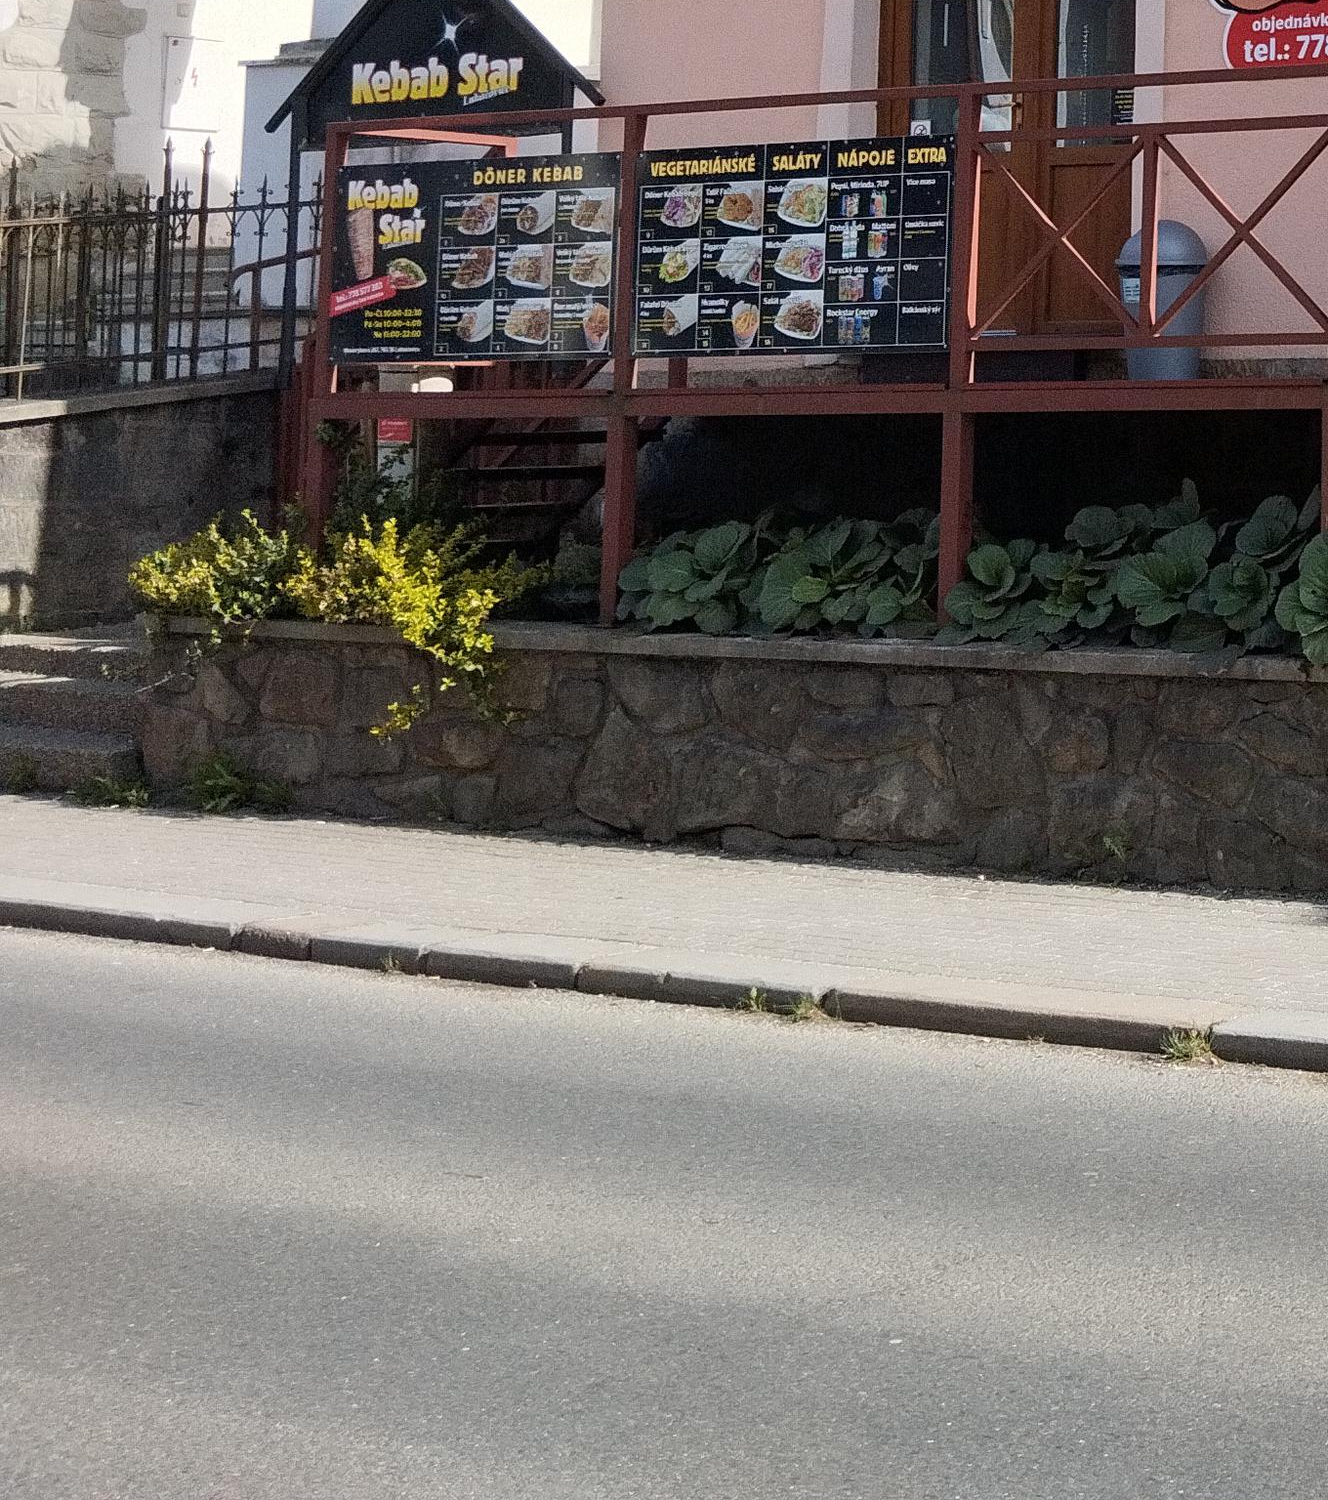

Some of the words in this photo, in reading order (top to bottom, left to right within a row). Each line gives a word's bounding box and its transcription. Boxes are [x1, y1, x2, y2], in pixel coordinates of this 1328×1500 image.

[1243, 39, 1291, 62] tel.:
[352, 56, 449, 105] Kebab
[457, 52, 523, 96] Star
[651, 153, 756, 177] VEGETARIÁNSKÉ
[772, 151, 822, 171] SALÁTY
[837, 148, 896, 168] NÁPOJE
[907, 147, 947, 164] EXTRA
[473, 166, 526, 185] DÖNER
[532, 165, 583, 183] KEBAB
[347, 178, 419, 211] Kebab
[378, 213, 426, 245] Star
